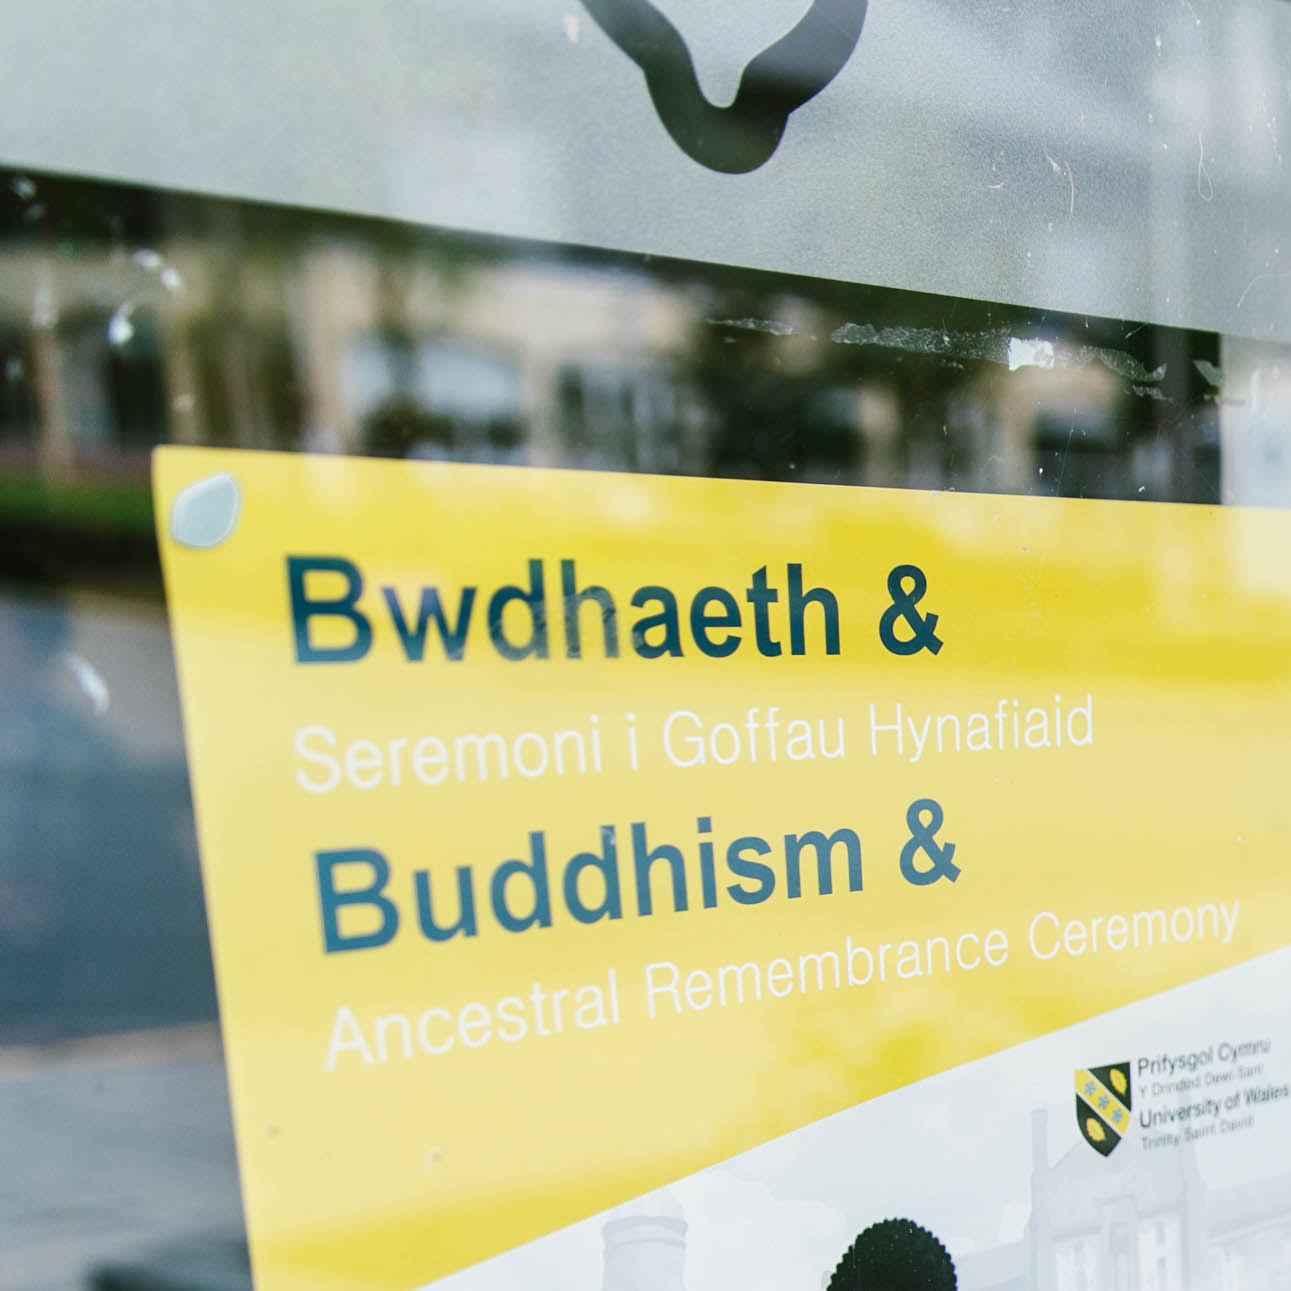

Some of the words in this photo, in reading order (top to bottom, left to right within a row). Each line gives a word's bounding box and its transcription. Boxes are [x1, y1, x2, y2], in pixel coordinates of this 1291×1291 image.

[285, 554, 841, 664] Bwdhaeth
[879, 563, 943, 657] &
[294, 716, 602, 793] Seremoni
[627, 716, 639, 770] i
[664, 708, 845, 768] Goffau
[870, 695, 1094, 763] Hynafiaid
[314, 816, 864, 954] Buddhism
[900, 799, 962, 885] &
[323, 973, 619, 1071] Ancestral
[647, 925, 1008, 1020] Remembrance
[1029, 900, 1240, 962] Ceremony
[1137, 1046, 1214, 1076] Prifysgol
[1139, 1098, 1222, 1128] University
[1225, 1092, 1241, 1110] of
[1245, 1083, 1291, 1105] Wales
